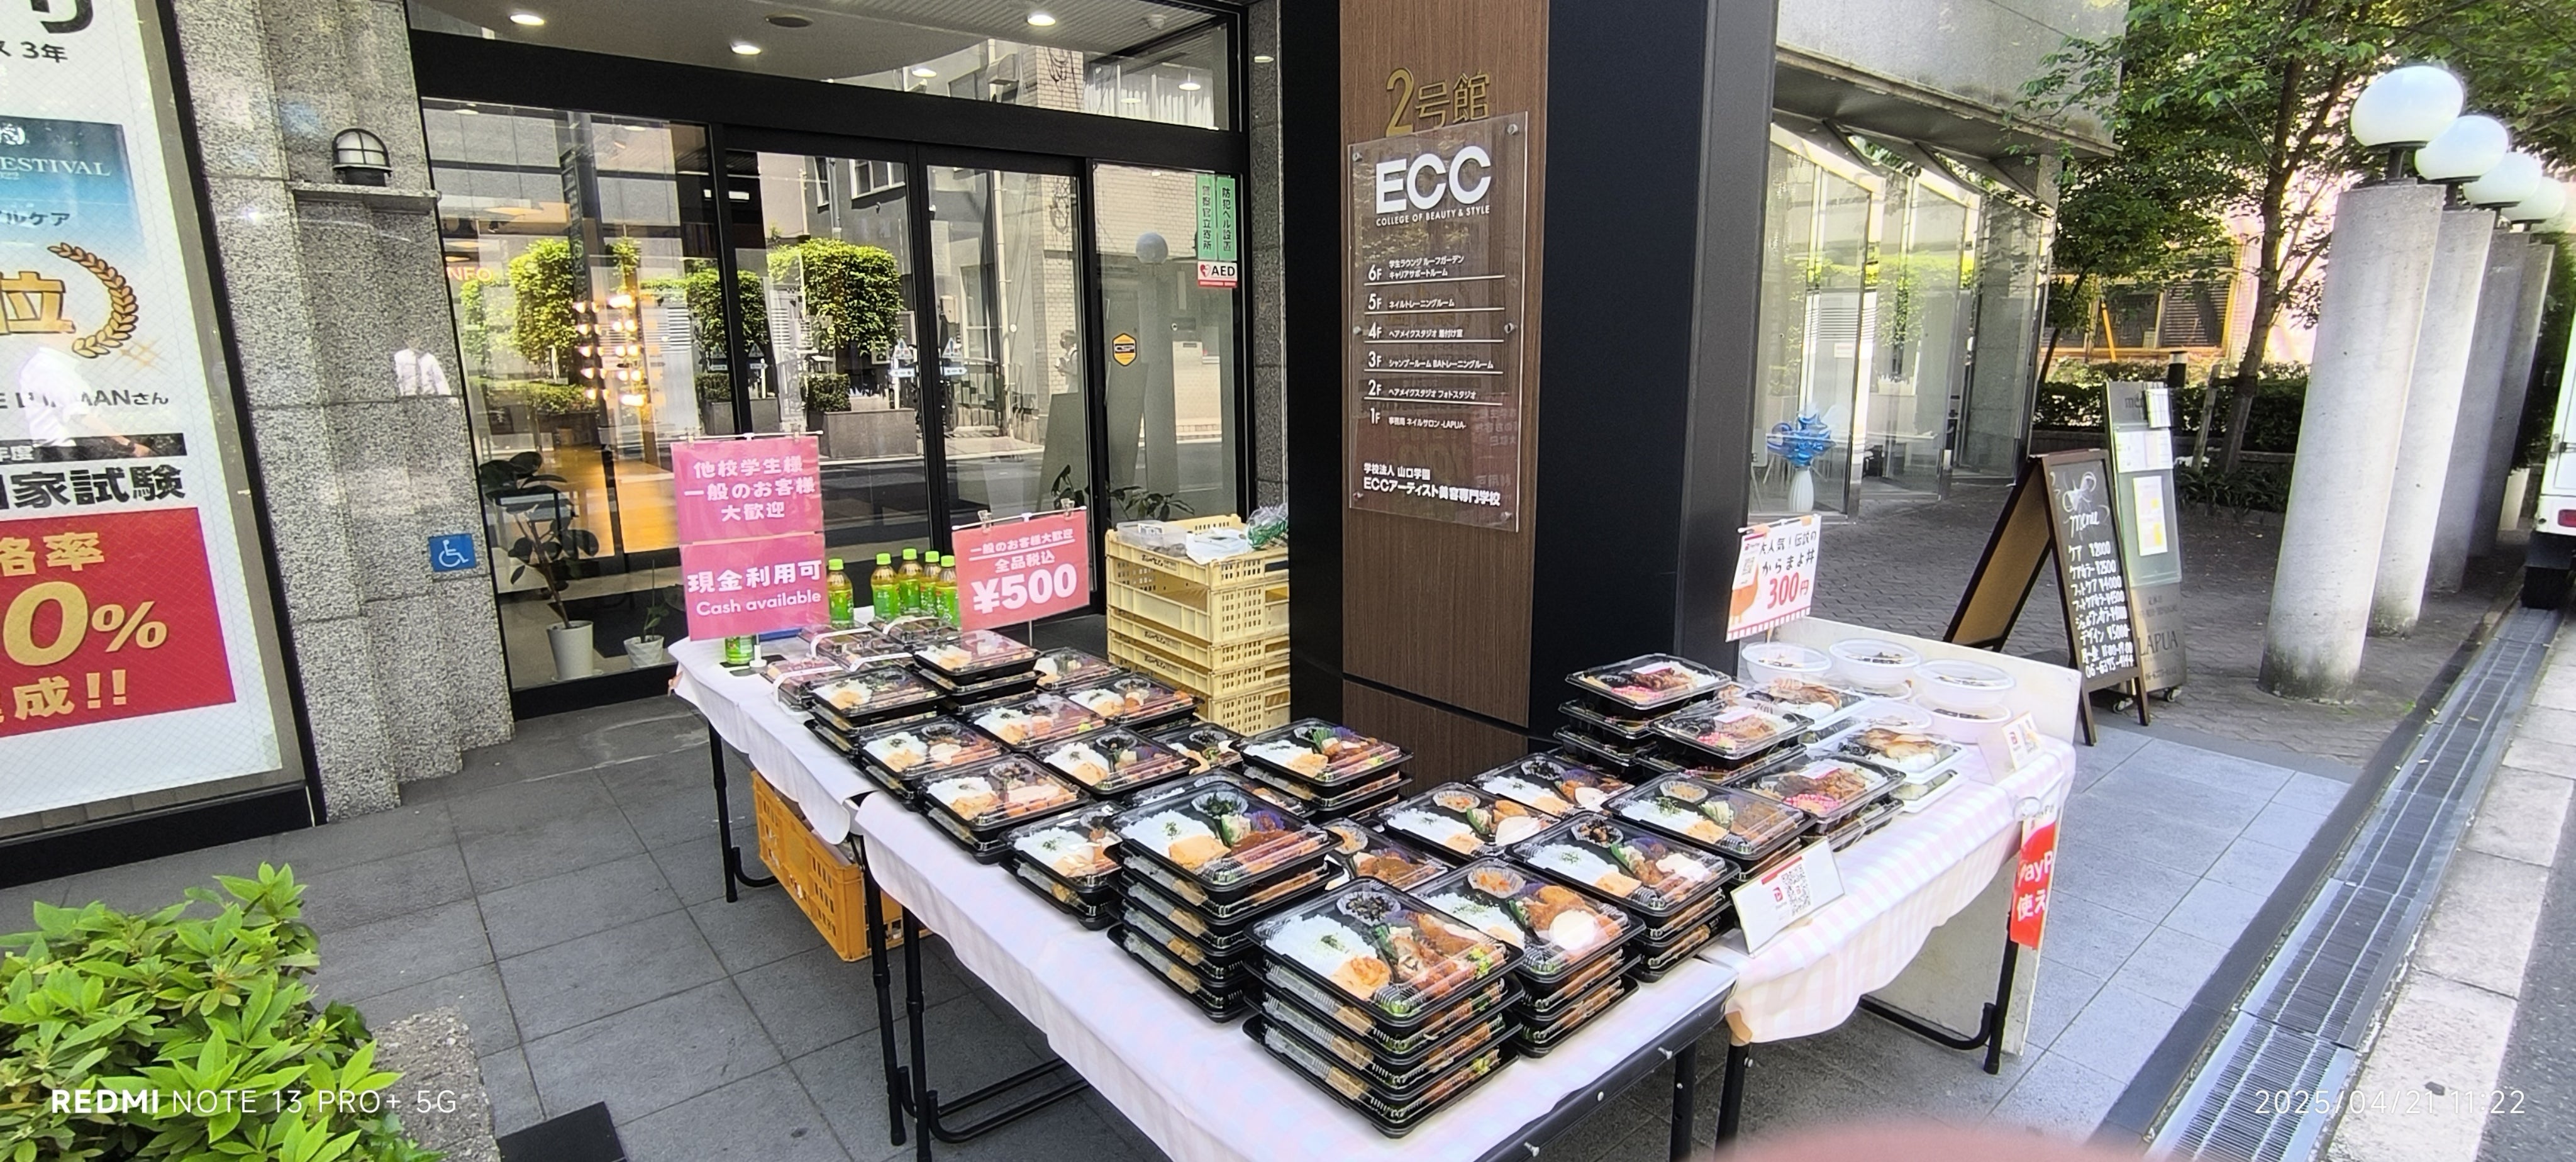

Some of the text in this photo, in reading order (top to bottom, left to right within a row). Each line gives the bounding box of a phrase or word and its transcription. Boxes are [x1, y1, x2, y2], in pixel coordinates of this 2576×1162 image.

[20, 41, 68, 63] 3年
[1386, 67, 1491, 138] 2号館
[1376, 145, 1492, 215] ECC
[1376, 205, 1491, 227] COLLEGE OF BEAUTY & STYLE
[1211, 265, 1235, 277] AED
[1368, 264, 1382, 281] 6F
[1368, 293, 1382, 310] 5F
[1368, 321, 1382, 339] 4F
[1368, 350, 1382, 367] 3F
[1368, 379, 1382, 396] 2F
[1370, 408, 1380, 425] 1F
[693, 455, 803, 479] 他校学生様
[1363, 462, 1431, 481] 学校法人 山口学園
[0, 464, 186, 510] 家試験
[684, 477, 816, 501] 一般のお客様
[1363, 476, 1501, 506] ECCアーティスト美容専門学校
[721, 501, 786, 522] 大歓迎
[970, 528, 1074, 554] 一般のお客様大歓迎
[995, 550, 1055, 573] 全品税込
[687, 560, 822, 593] 現金利用可
[970, 563, 1077, 614] ¥500
[696, 589, 822, 617] Cash available
